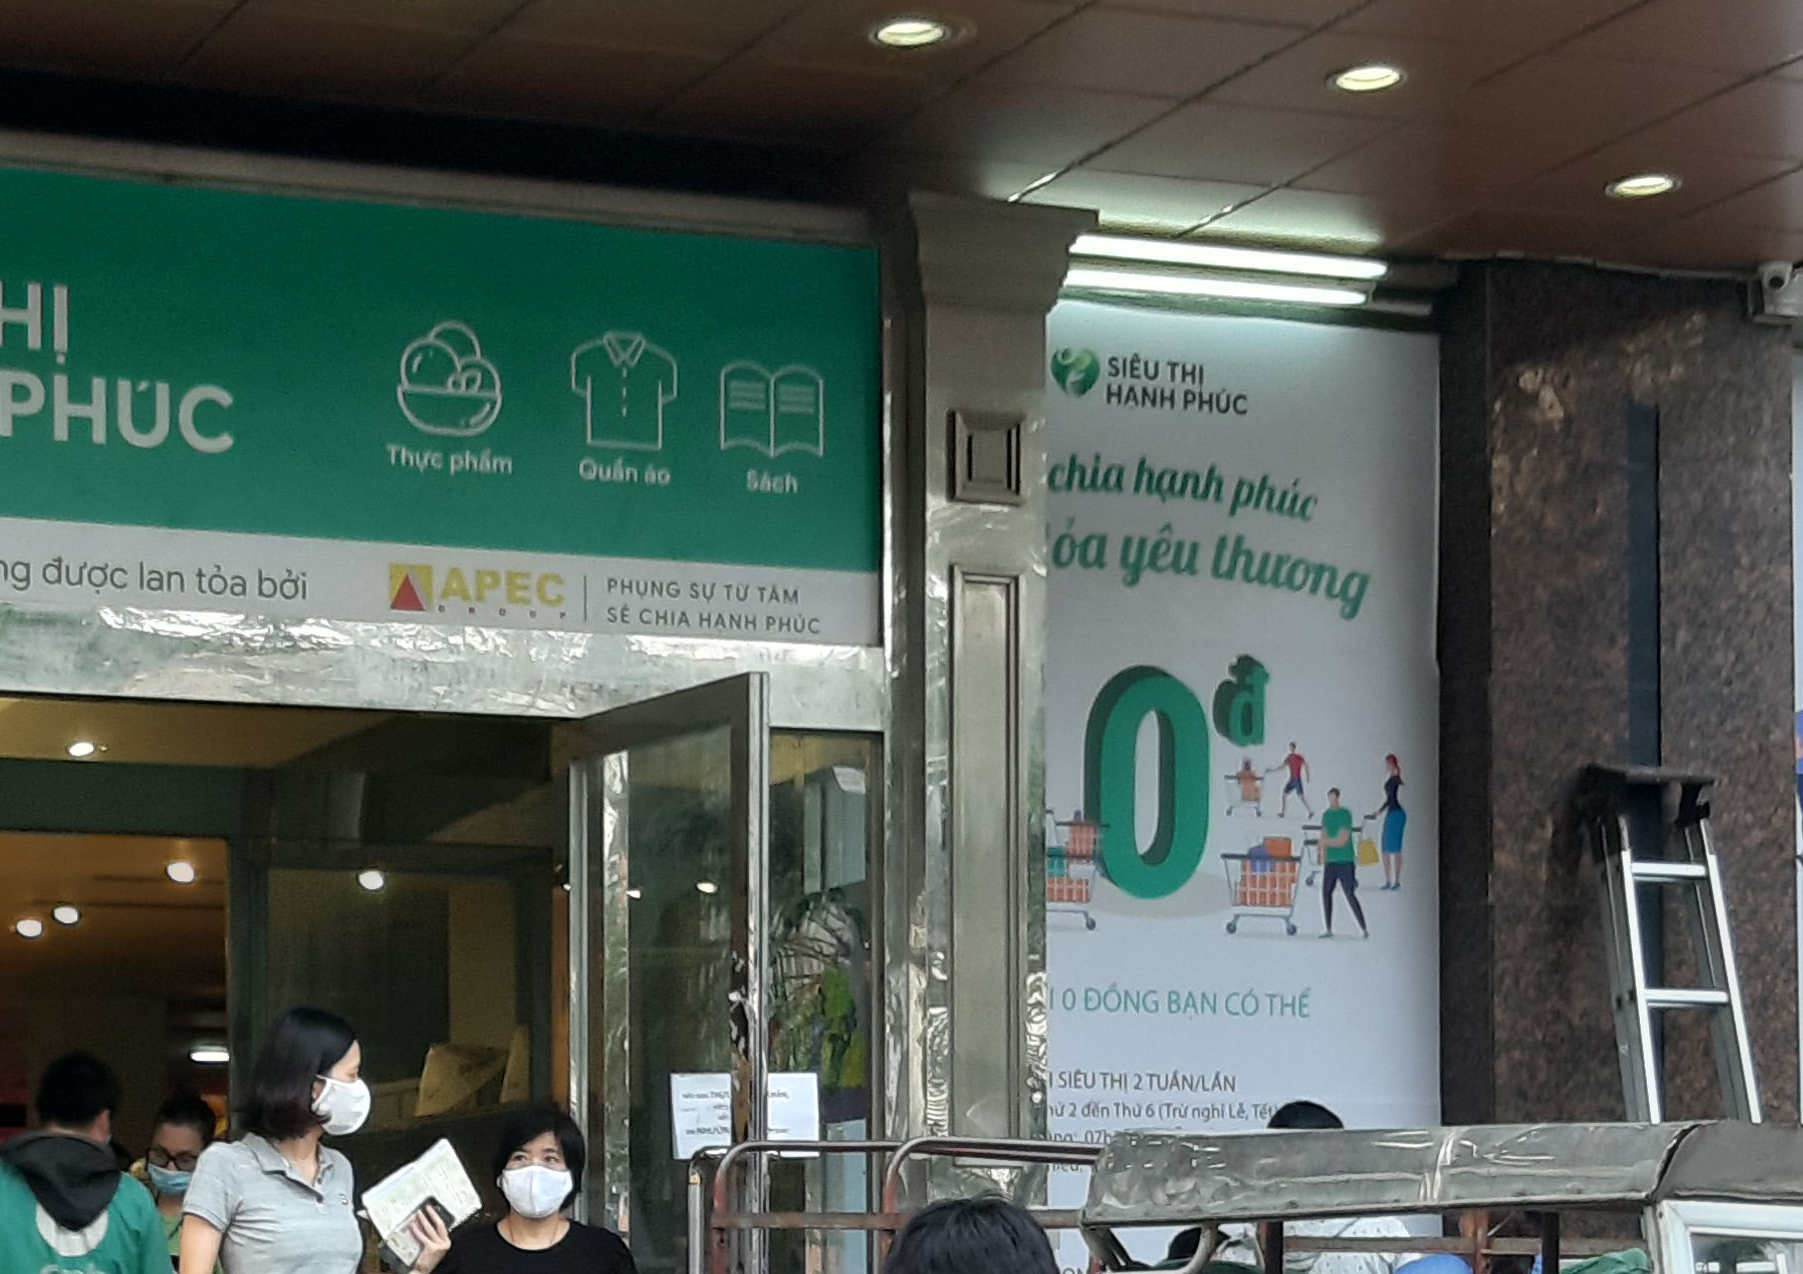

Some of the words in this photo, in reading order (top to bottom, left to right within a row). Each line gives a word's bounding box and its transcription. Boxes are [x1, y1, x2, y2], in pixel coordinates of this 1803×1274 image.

[1107, 352, 1160, 381] SIÊU
[1167, 361, 1204, 387] THỊ
[1105, 383, 1176, 411] HẠNH
[1182, 388, 1248, 416] PHÚC
[386, 443, 444, 473] Thực
[449, 447, 514, 476] phẩm
[644, 462, 672, 486] áo
[746, 468, 799, 495] Sách
[1047, 451, 1125, 495] chia
[1133, 456, 1225, 505] hạnh
[1228, 474, 1318, 523] phúc
[1046, 517, 1108, 570] ỏa
[1118, 521, 1200, 588] yêu
[41, 555, 129, 596] được
[139, 560, 185, 594] lan
[195, 563, 248, 598] tỏa
[257, 568, 310, 602] bởi
[439, 565, 566, 608] APEC
[638, 608, 691, 629] CHIA
[765, 612, 821, 635] PHÚC
[1061, 987, 1077, 1012] 0
[1167, 989, 1218, 1021] BẠN
[1224, 987, 1259, 1017] CÓ
[1057, 1068, 1096, 1090] SIÊU
[1099, 1071, 1128, 1096] THỊ
[1133, 1073, 1143, 1091] 2
[1068, 1102, 1077, 1118] 2
[1081, 1099, 1110, 1118] đến
[1113, 1101, 1143, 1119] Thứ
[1145, 1102, 1155, 1119] 6
[1191, 1102, 1225, 1122] nghỉ
